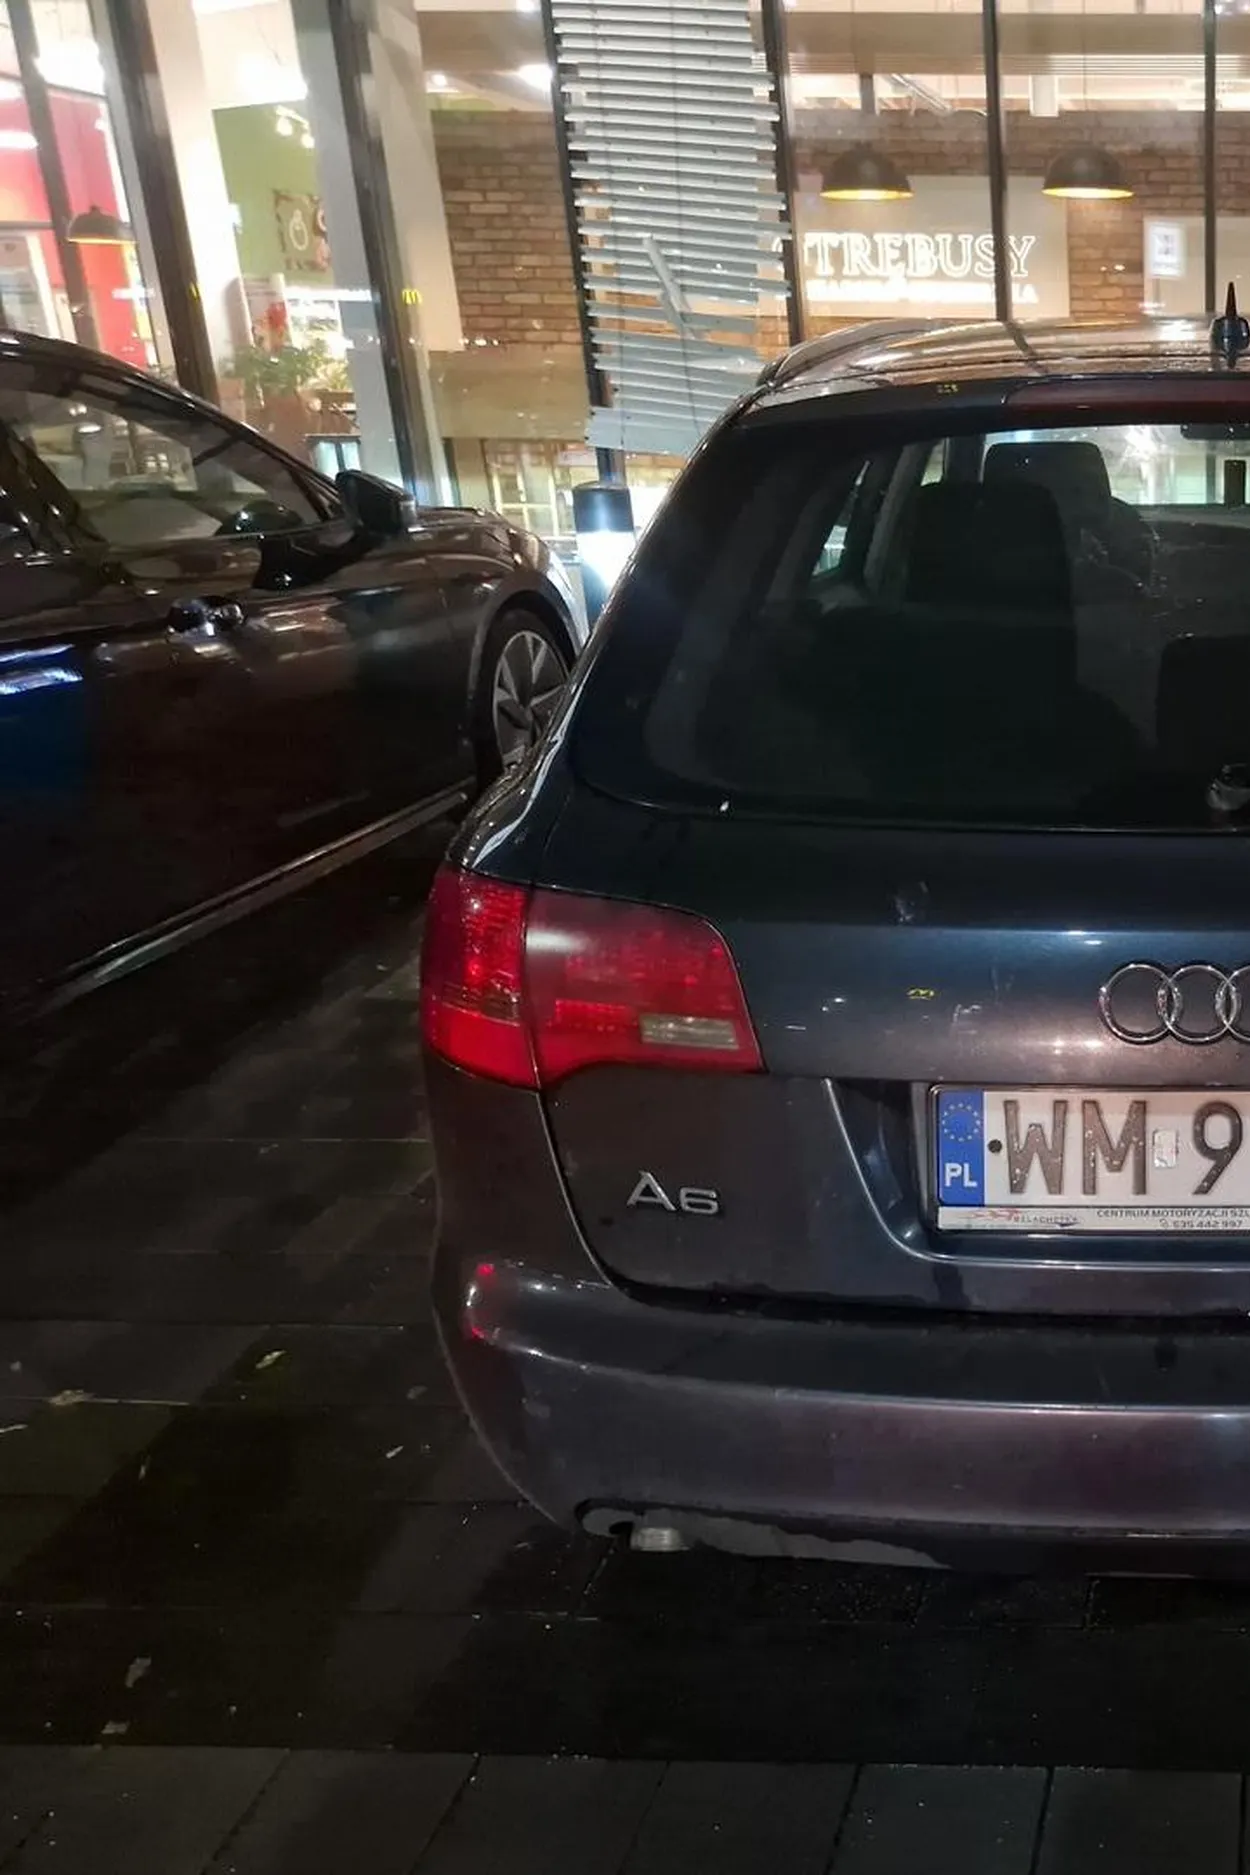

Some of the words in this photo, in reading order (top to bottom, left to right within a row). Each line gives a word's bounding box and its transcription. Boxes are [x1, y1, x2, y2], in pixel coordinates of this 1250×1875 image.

[1003, 1099, 1147, 1196] WM
[943, 1162, 977, 1187] PL
[626, 1170, 719, 1214] A6
[1096, 1209, 1149, 1218] CENTRUM
[1151, 1209, 1229, 1218] MOTORYZACJI
